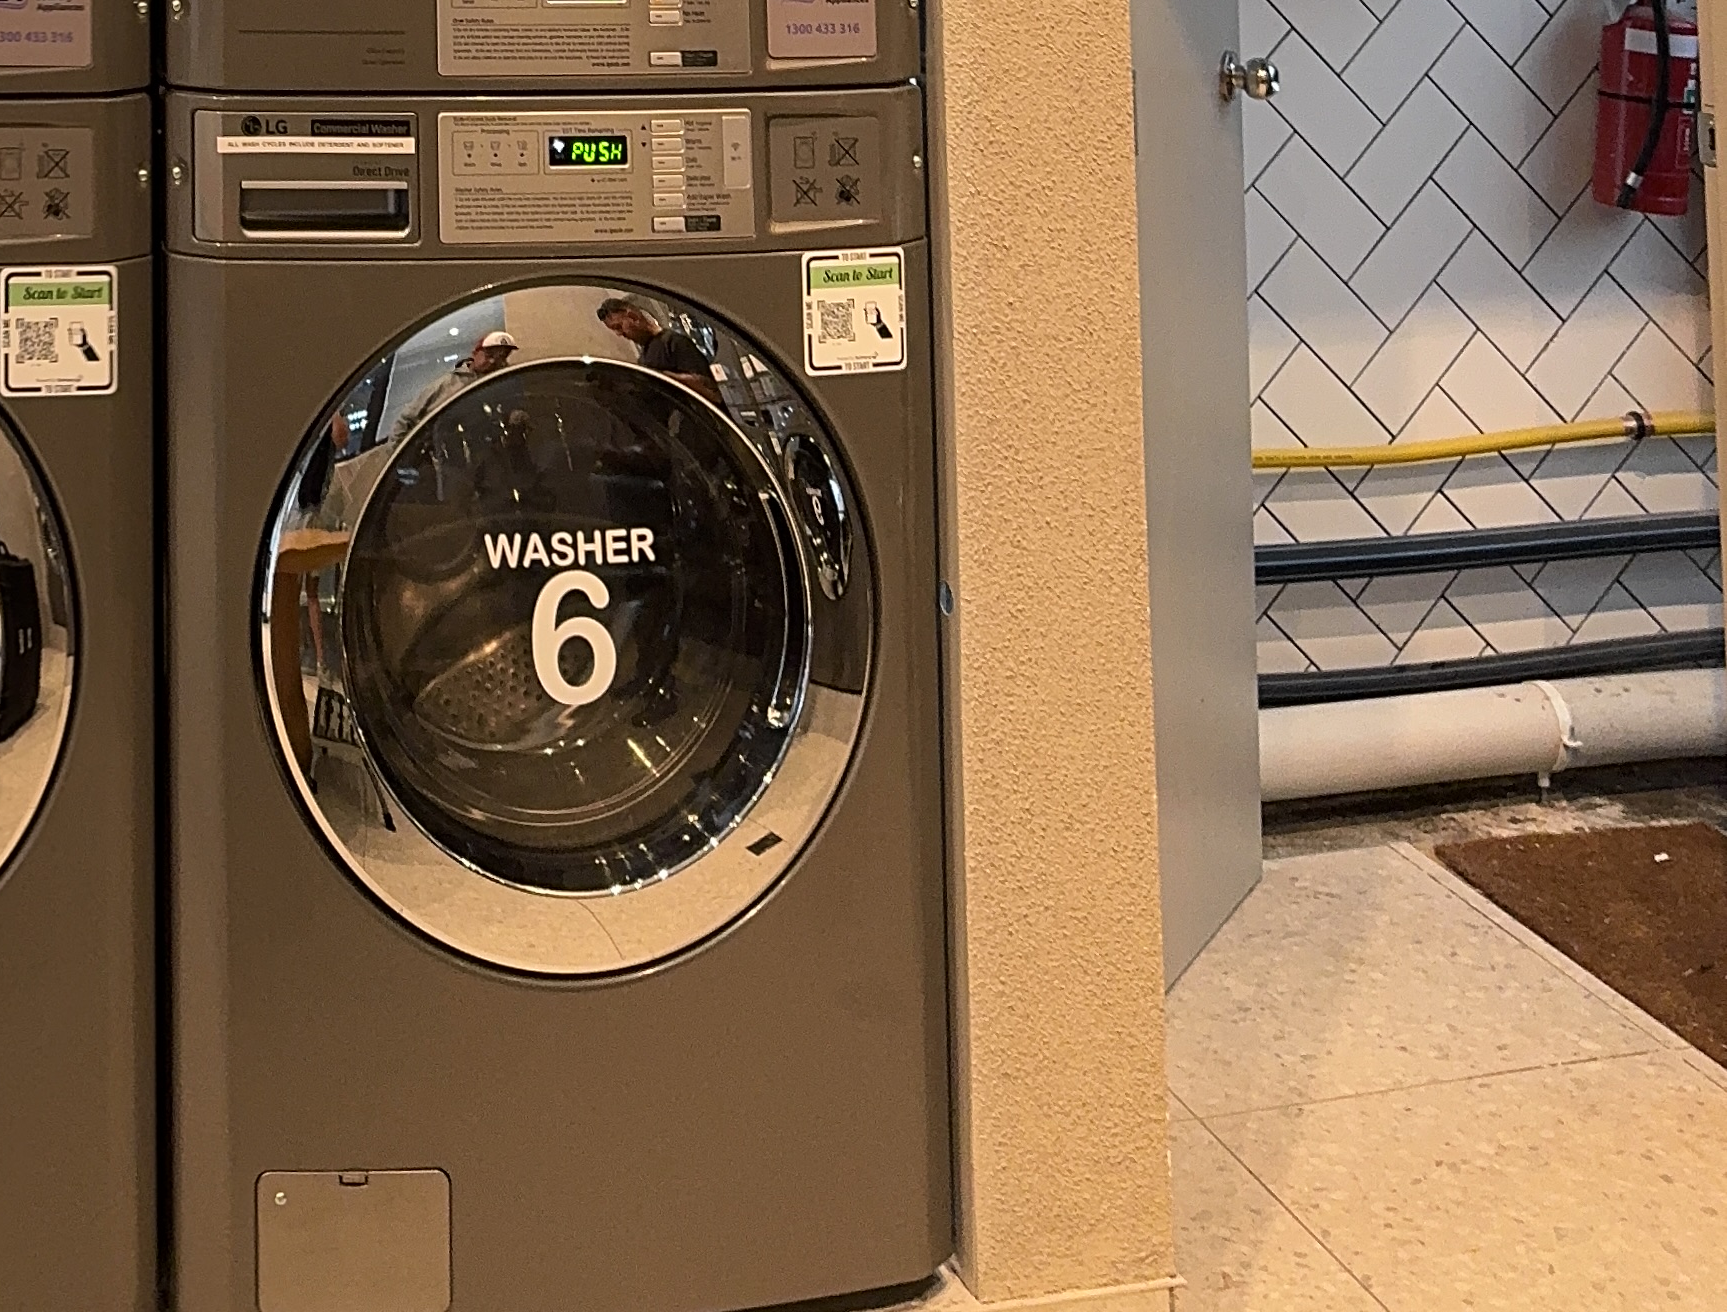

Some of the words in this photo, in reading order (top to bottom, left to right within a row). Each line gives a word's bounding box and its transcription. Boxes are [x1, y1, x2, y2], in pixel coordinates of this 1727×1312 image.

[786, 23, 812, 34] 1300
[815, 23, 836, 34] 433
[840, 23, 860, 34] 316
[266, 119, 288, 134] LG
[571, 141, 622, 162] PUSH
[823, 270, 850, 283] Scan
[852, 270, 862, 281] to
[866, 267, 893, 280] Start
[23, 286, 53, 300] Scan
[56, 288, 68, 299] to
[71, 286, 103, 299] Start
[483, 527, 656, 570] WASHER
[529, 569, 618, 706] 6
